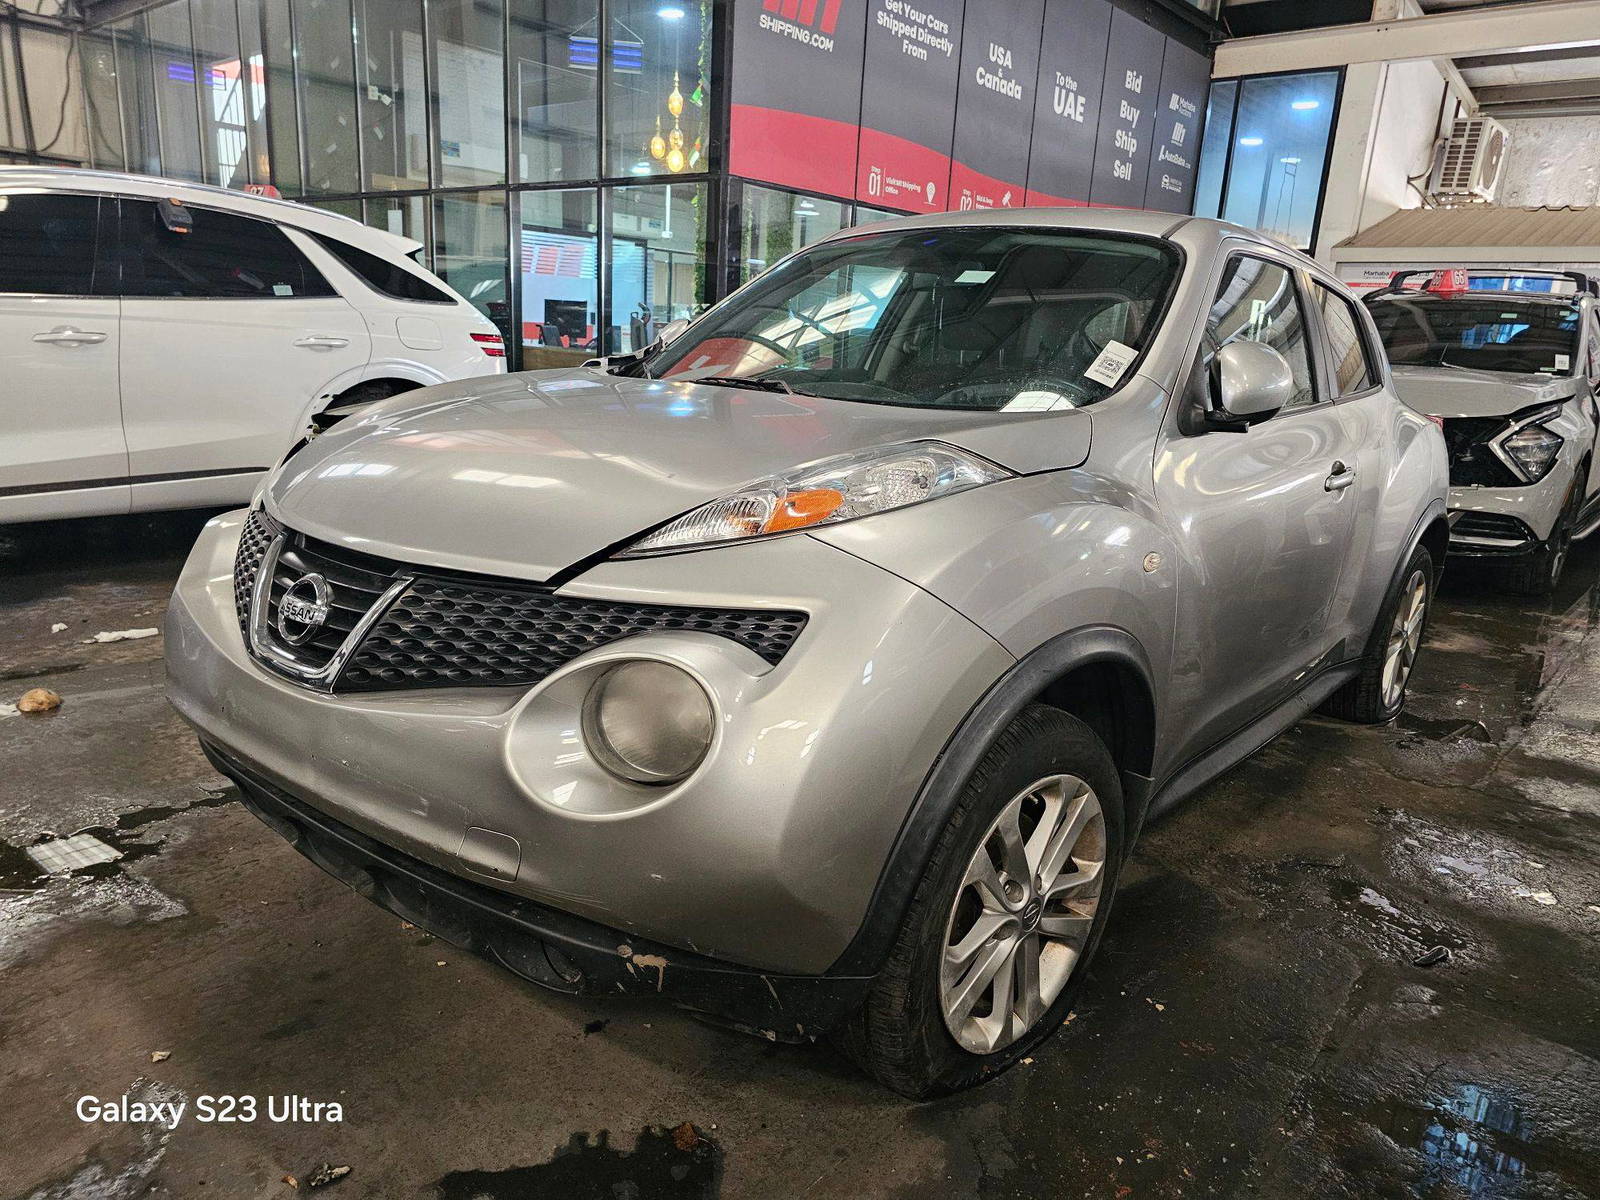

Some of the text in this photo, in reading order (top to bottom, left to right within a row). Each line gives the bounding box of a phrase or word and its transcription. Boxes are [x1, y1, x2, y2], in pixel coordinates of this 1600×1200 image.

[885, 0, 949, 34] Get Your Cars
[759, 14, 835, 52] SHIPPING.COM
[877, 11, 953, 57] Shipped Directly
[902, 39, 928, 61] From
[989, 43, 1012, 69] USA
[976, 66, 1023, 100] Canada
[1056, 71, 1078, 91] To the
[1125, 69, 1143, 94] Bid
[1053, 85, 1086, 123] UAE
[1120, 99, 1140, 129] Buy
[1115, 129, 1137, 158] Ship
[1113, 159, 1132, 181] Sell
[868, 172, 881, 197] 01
[1454, 270, 1465, 286] 66
